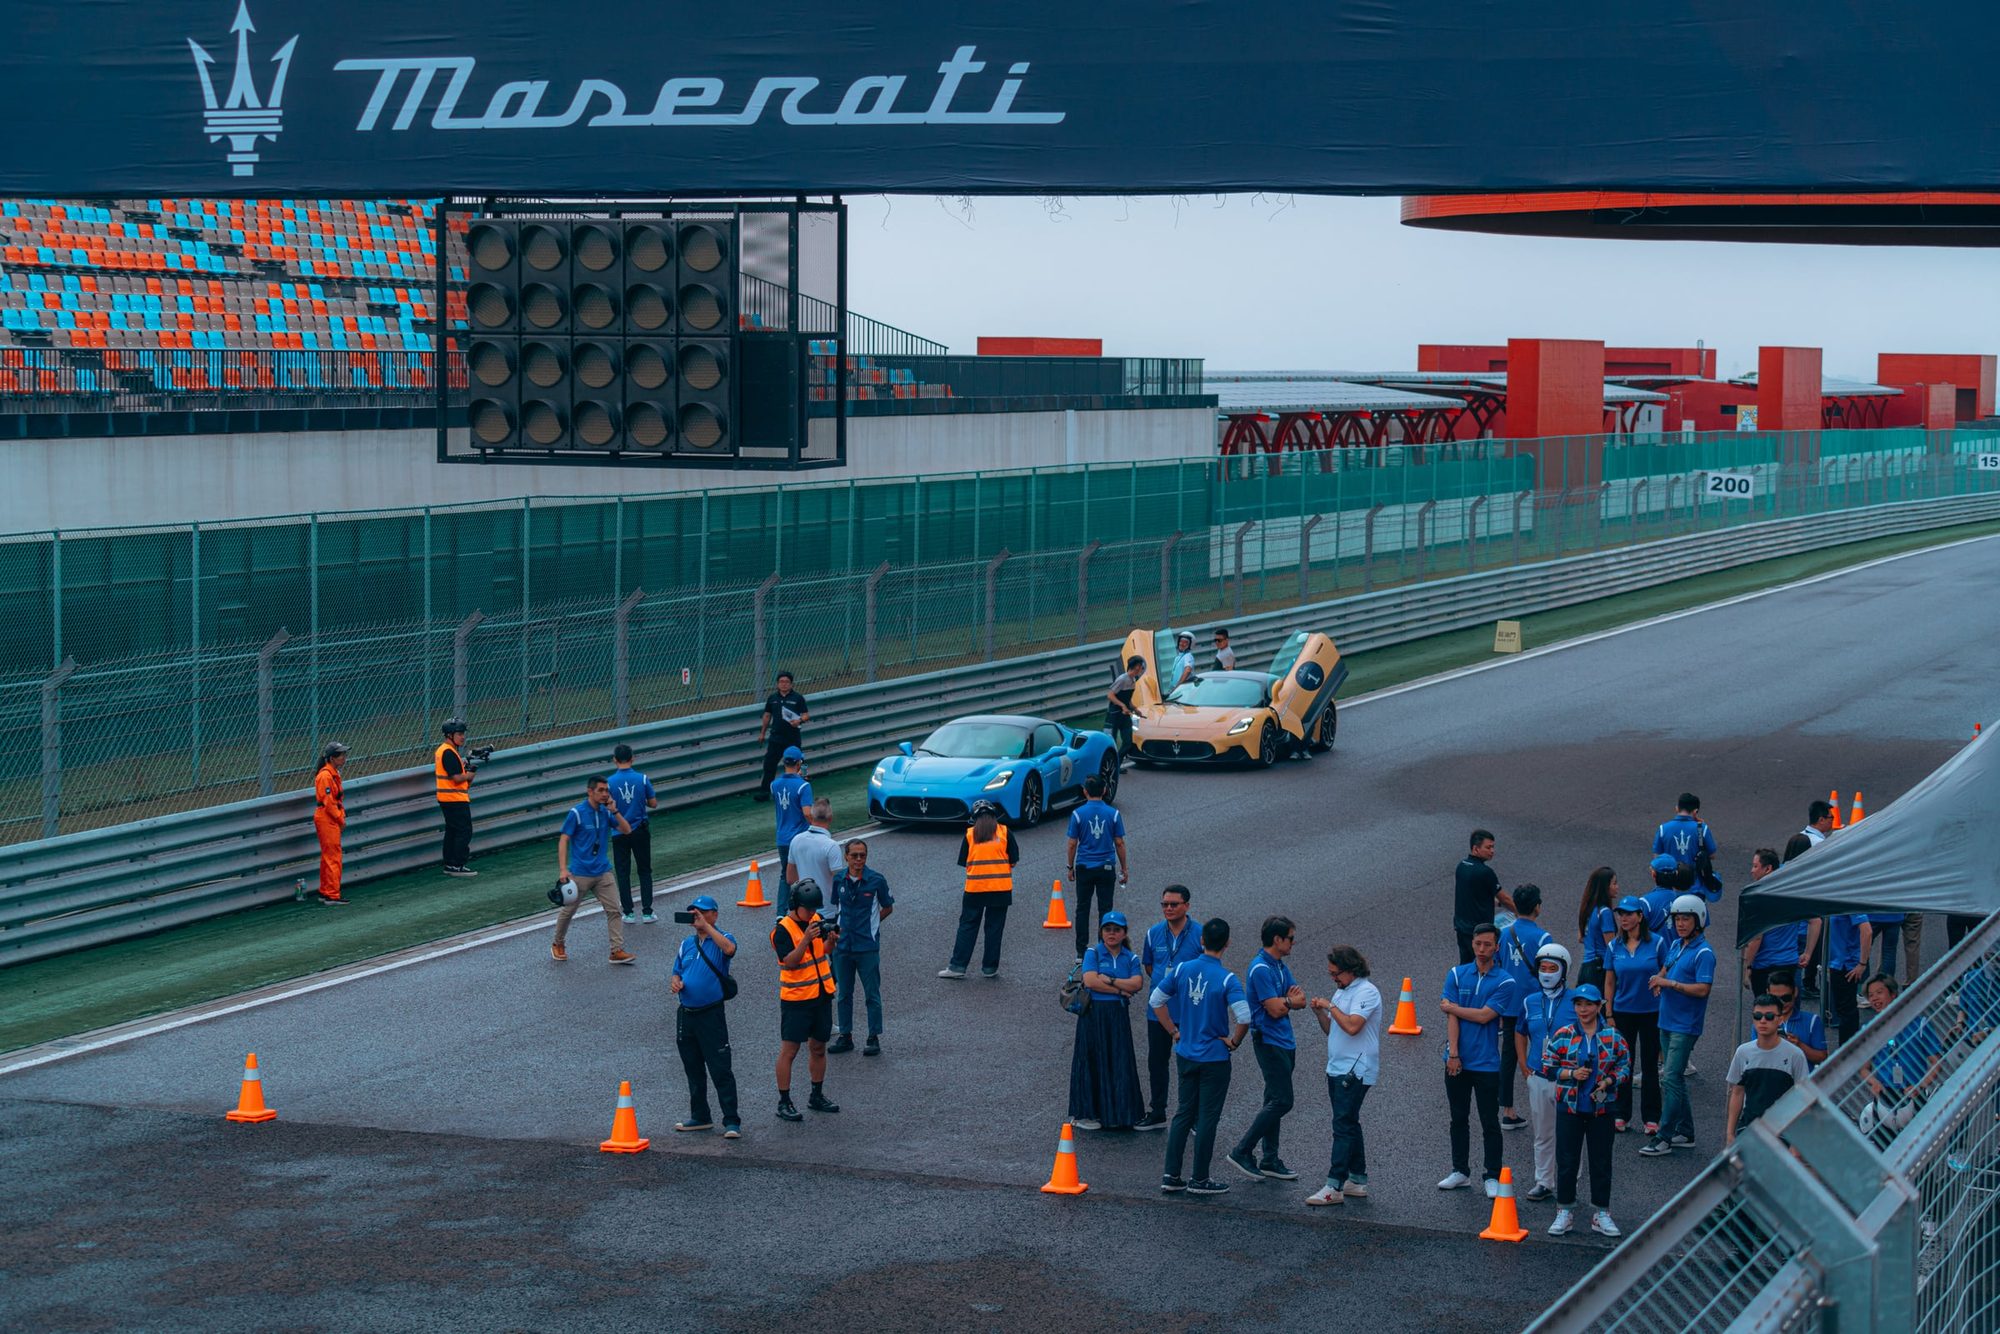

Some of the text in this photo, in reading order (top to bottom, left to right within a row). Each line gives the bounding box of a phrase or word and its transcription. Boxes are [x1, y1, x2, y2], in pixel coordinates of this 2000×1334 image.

[333, 45, 1066, 131] Maserati
[1710, 476, 1750, 494] 200
[683, 671, 688, 682] F
[1307, 672, 1321, 685] 1
